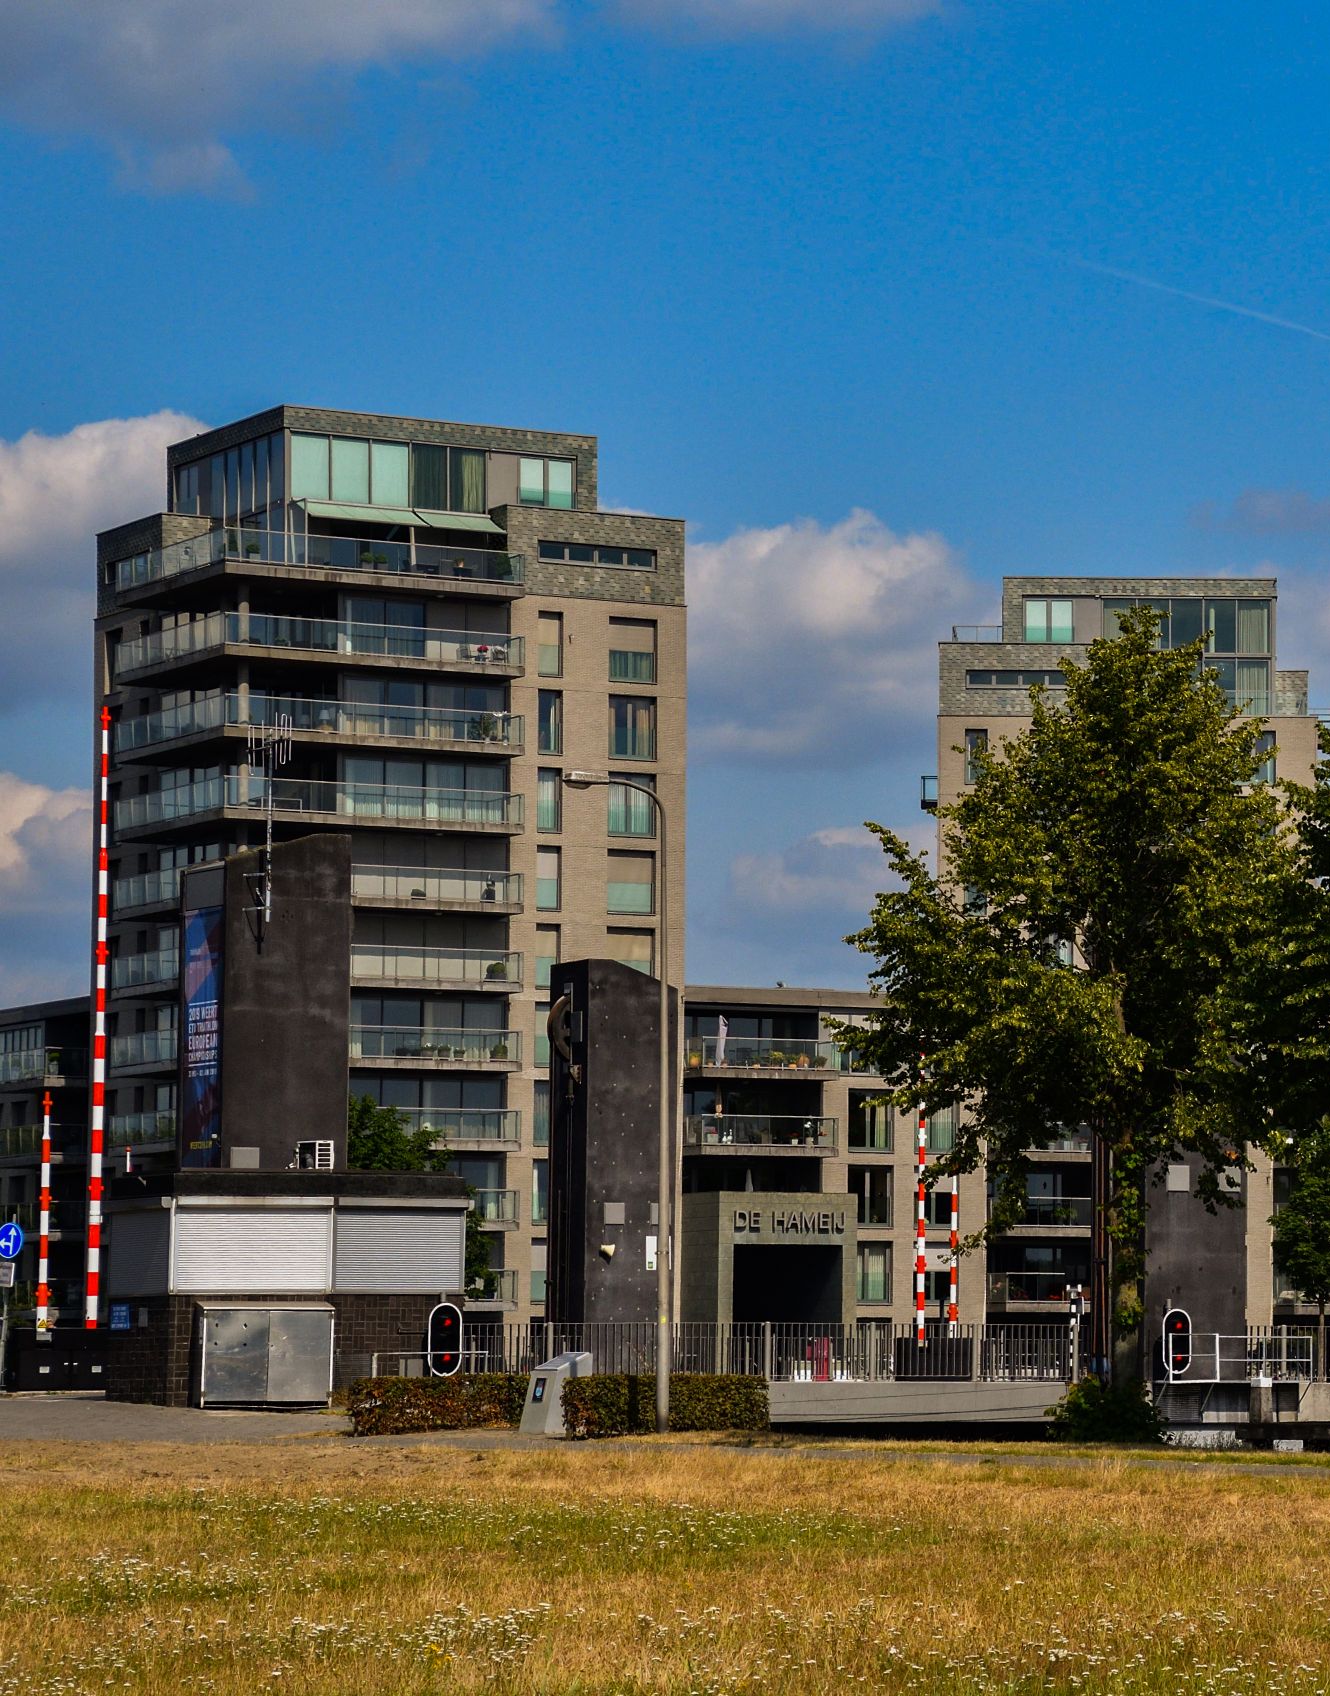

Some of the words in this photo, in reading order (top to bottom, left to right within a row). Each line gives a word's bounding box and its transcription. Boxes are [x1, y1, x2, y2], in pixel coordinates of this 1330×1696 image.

[201, 1005, 218, 1019] WEERT
[189, 1033, 218, 1050] EUROPEAN
[734, 1210, 761, 1233] DE
